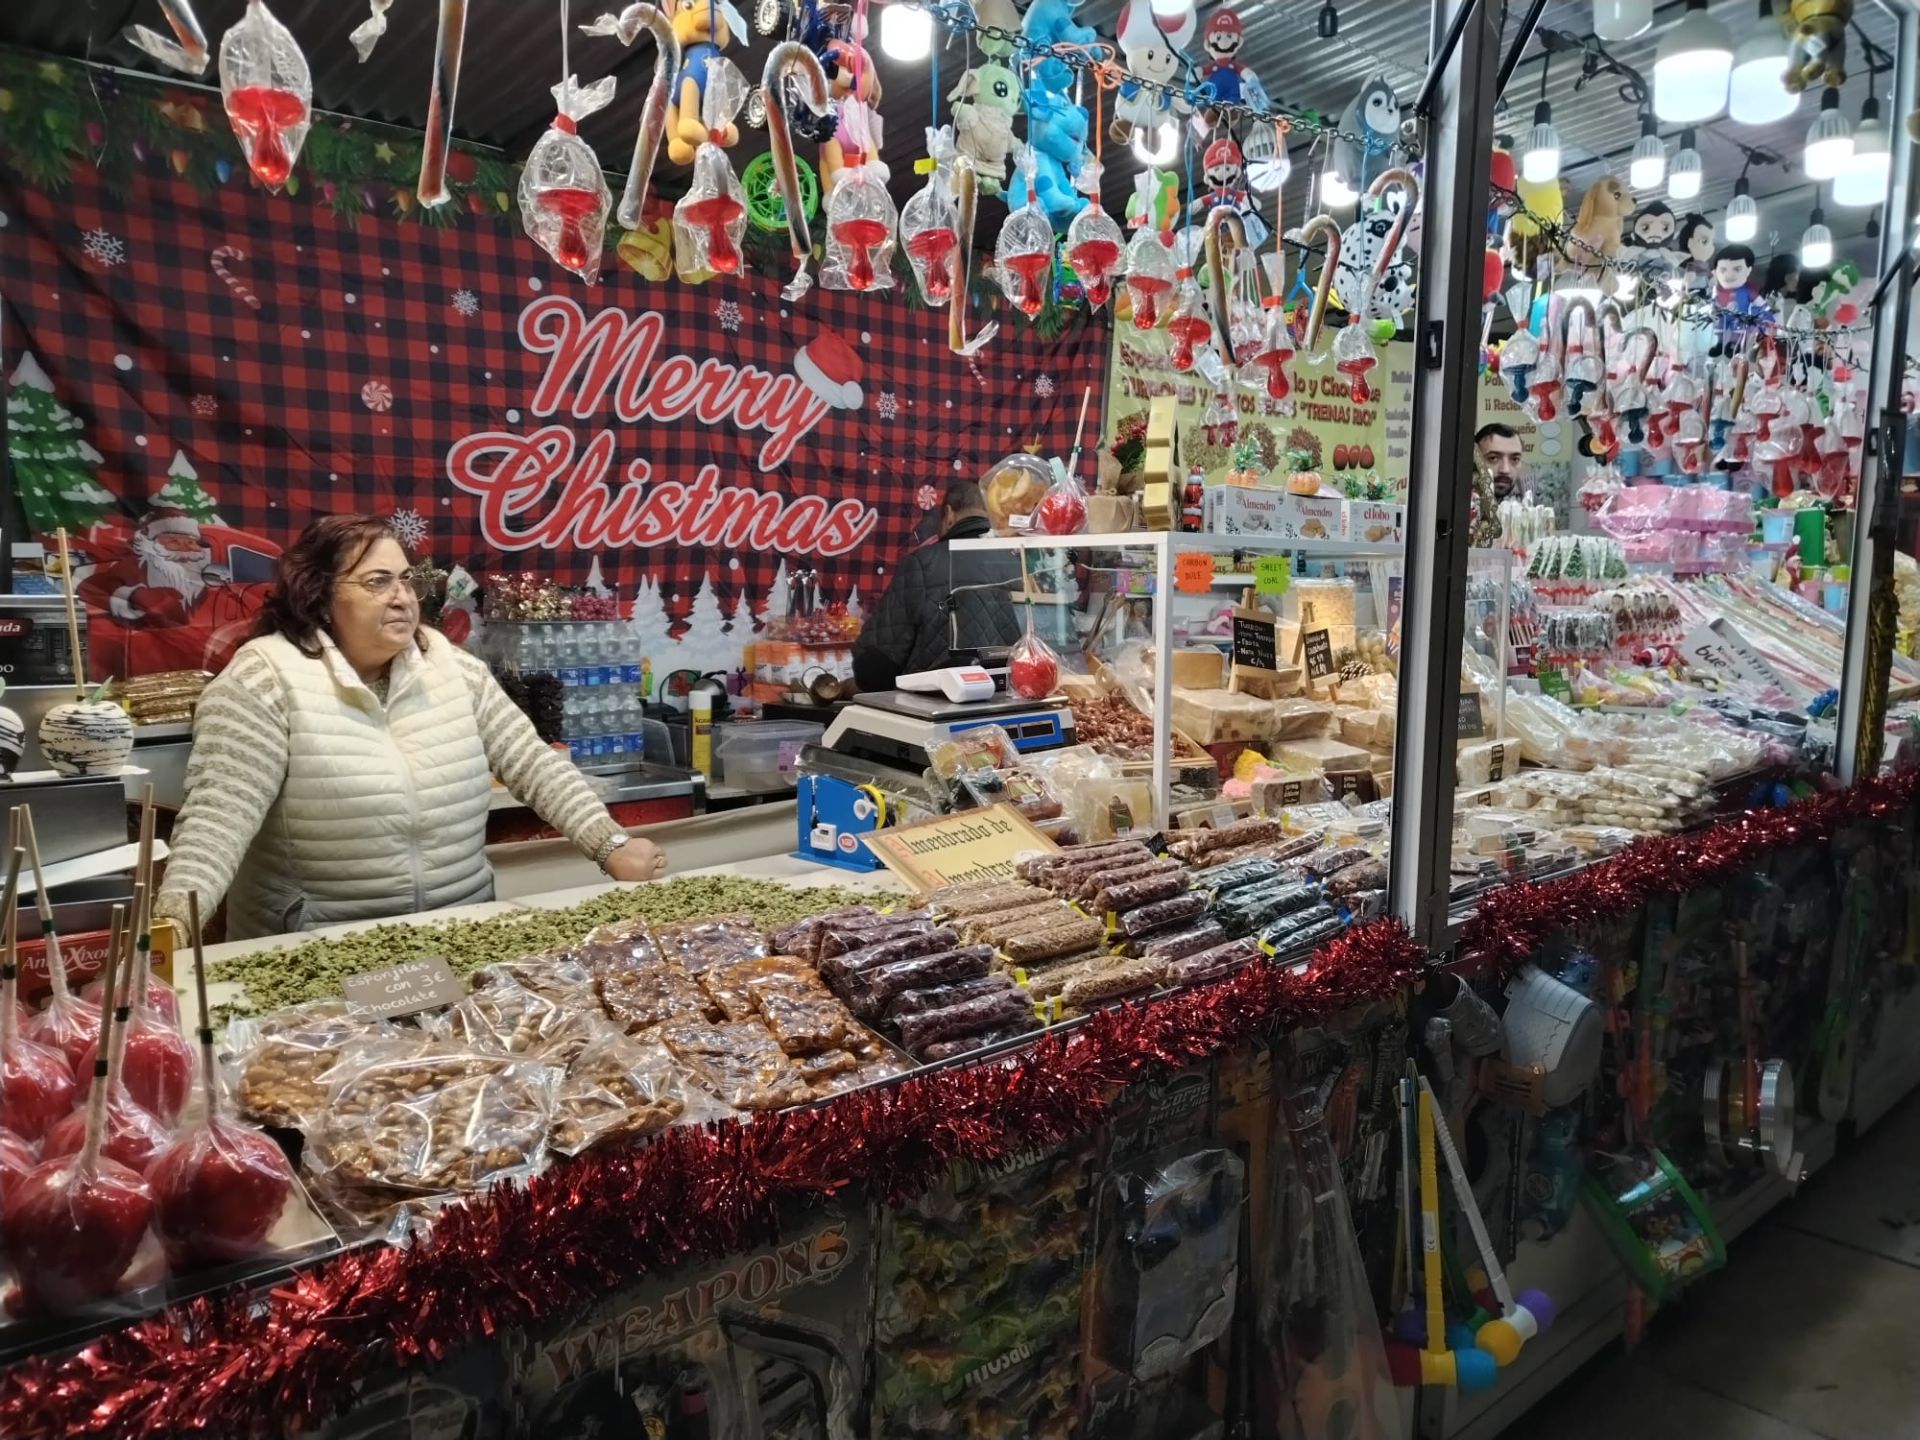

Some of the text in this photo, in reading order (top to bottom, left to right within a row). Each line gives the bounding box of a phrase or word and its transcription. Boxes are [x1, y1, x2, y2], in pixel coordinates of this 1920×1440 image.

[518, 295, 830, 472] Merry
[446, 425, 877, 557] Chistmas
[1242, 497, 1276, 512] Almendro
[983, 816, 1013, 834] de
[385, 971, 446, 994] con 3€
[542, 1221, 850, 1392] WEAPONS
